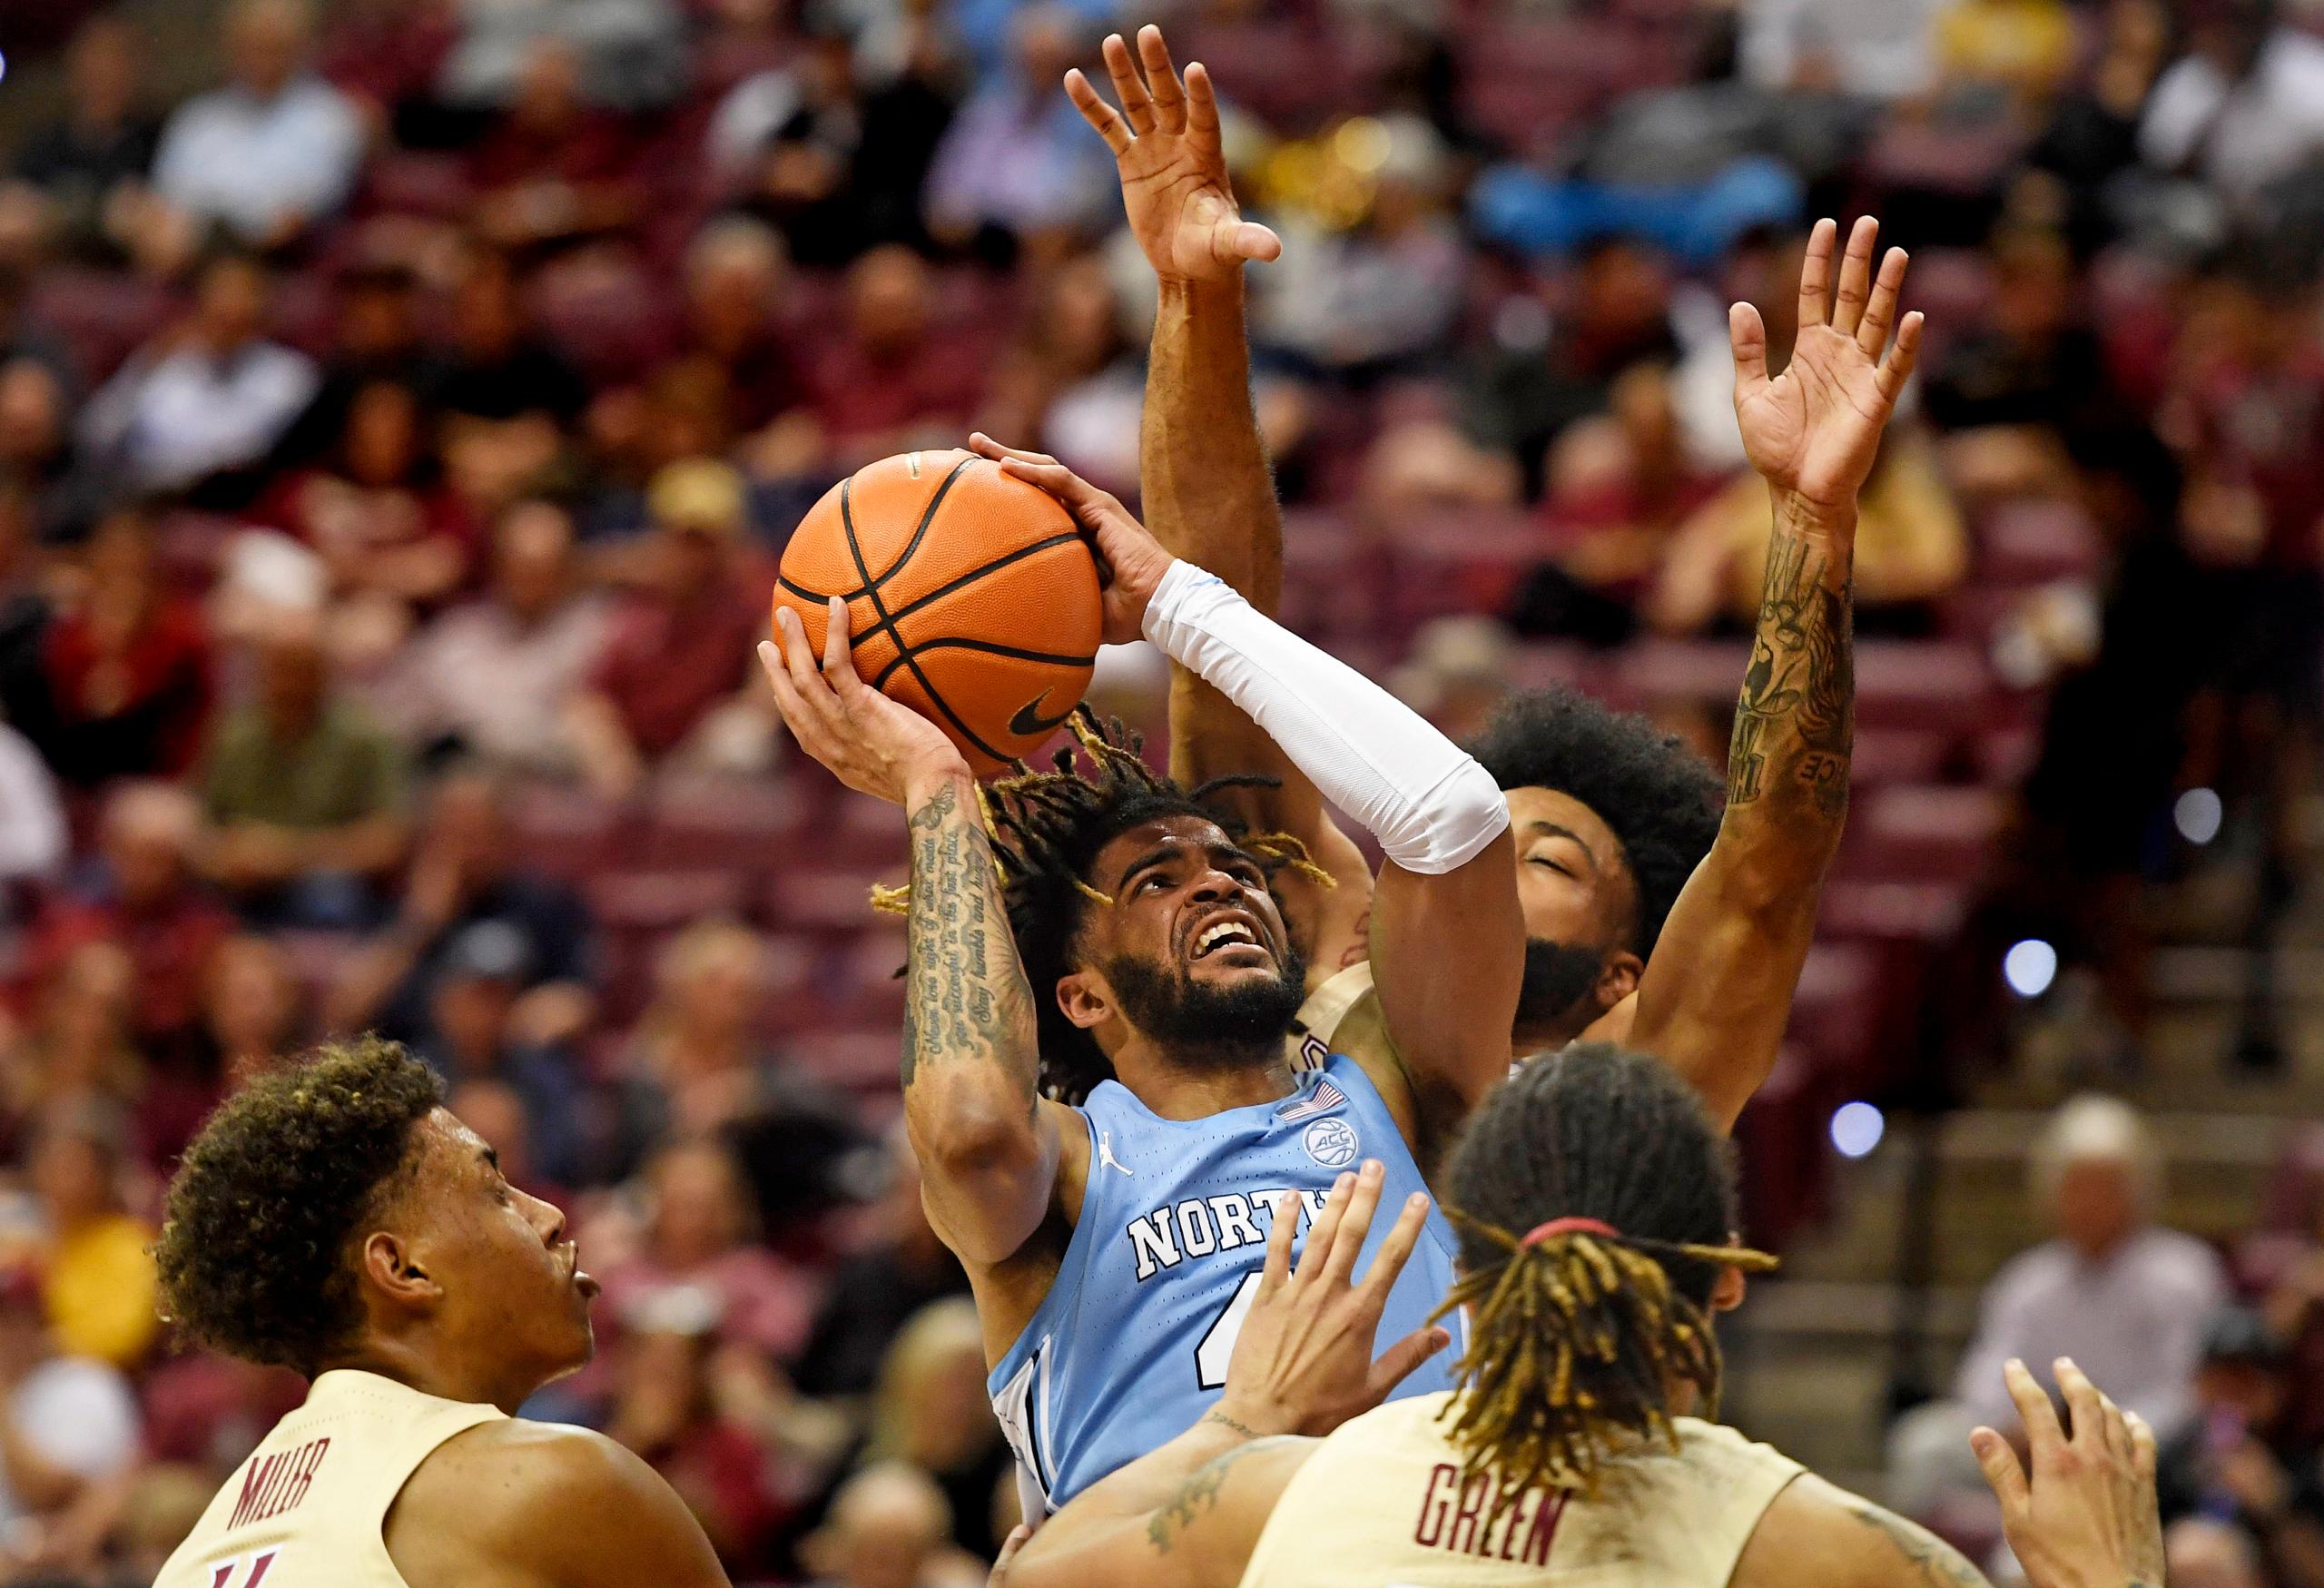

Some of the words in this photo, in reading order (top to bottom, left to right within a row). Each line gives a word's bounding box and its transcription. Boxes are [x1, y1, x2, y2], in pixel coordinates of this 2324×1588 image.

[921, 880, 935, 912] what
[940, 871, 962, 901] first
[940, 902, 957, 922] the
[969, 893, 985, 923] and
[921, 918, 939, 931] of
[922, 938, 940, 970] sight
[969, 929, 987, 980] humble
[924, 976, 938, 1002] lose
[972, 986, 996, 1023] Stay
[955, 1020, 975, 1050] you
[1315, 1130, 1351, 1149] ACC
[227, 1437, 330, 1531] MILLER
